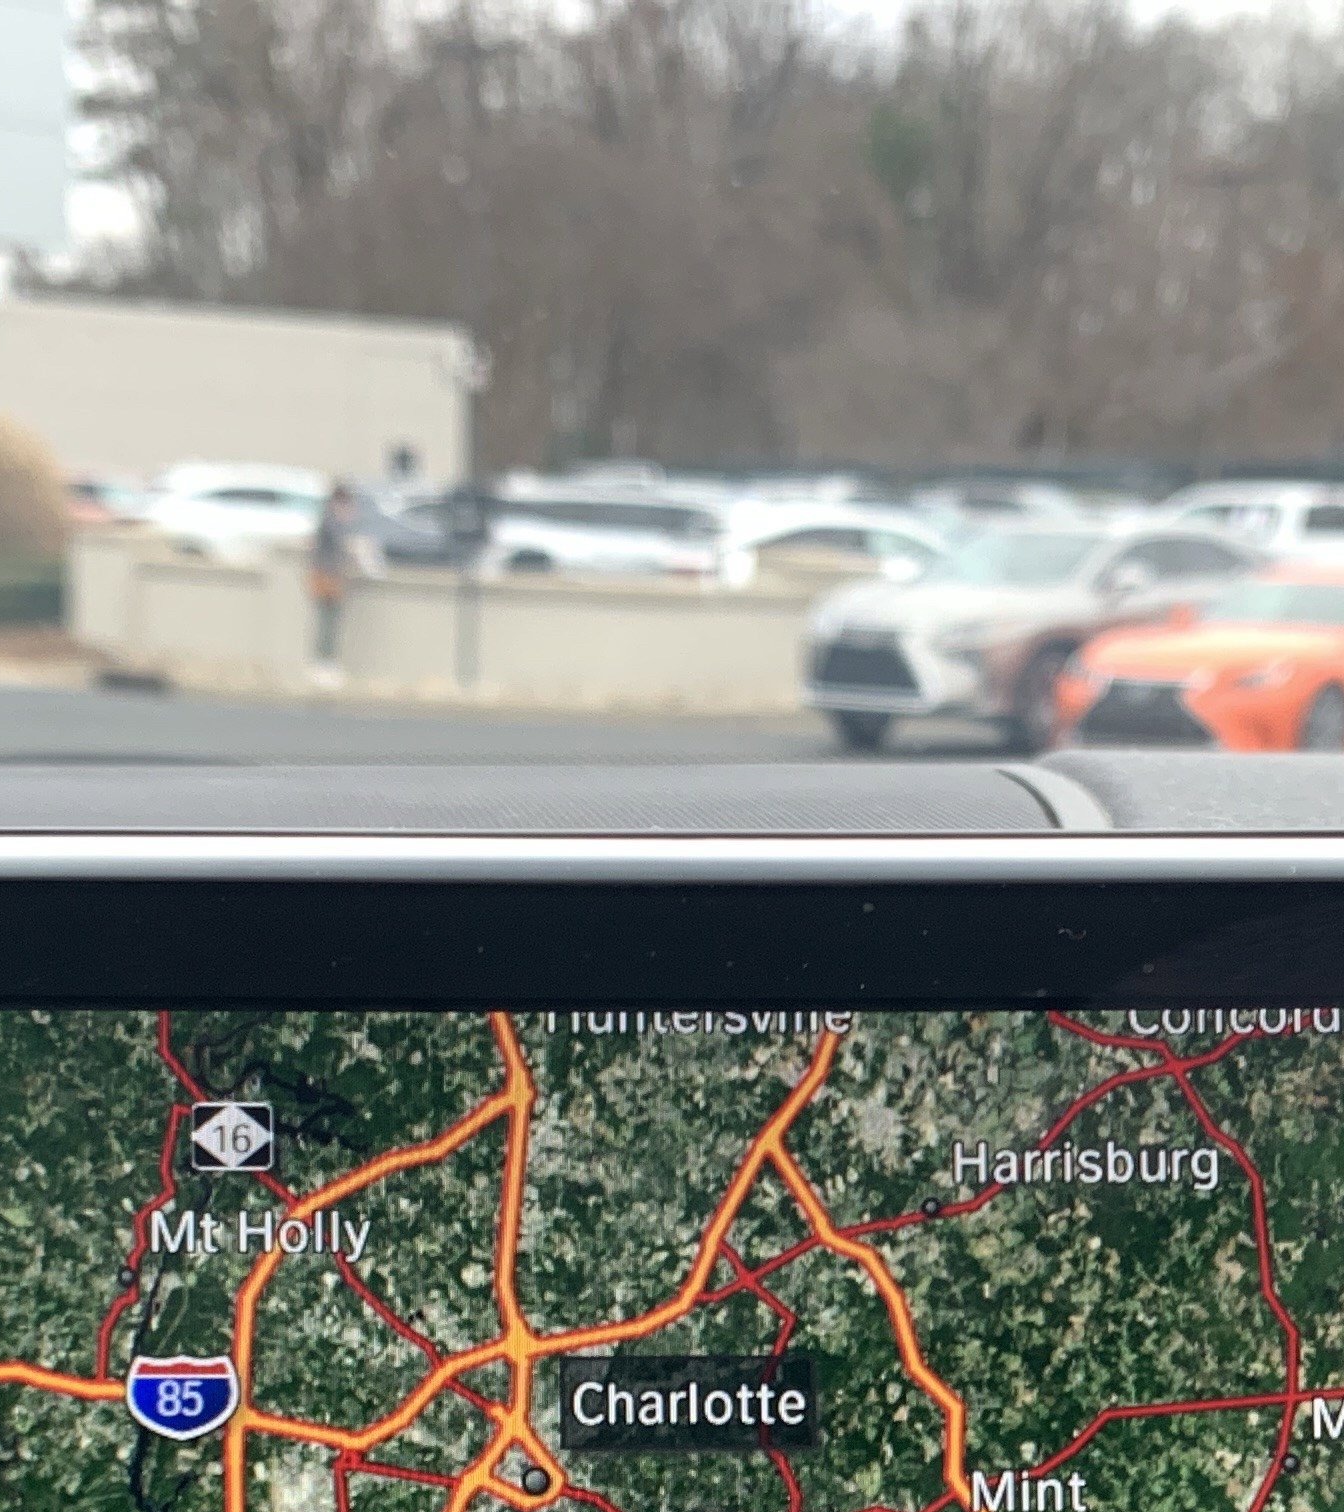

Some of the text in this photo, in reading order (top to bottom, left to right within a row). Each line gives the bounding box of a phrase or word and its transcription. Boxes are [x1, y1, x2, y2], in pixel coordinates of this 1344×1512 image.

[212, 1124, 252, 1155] 16
[954, 1142, 1219, 1190] Harrisburg
[151, 1211, 371, 1262] Mt Holly
[156, 1380, 204, 1417] 85
[572, 1380, 806, 1426] Charlotte
[970, 1470, 1087, 1512] Mint
